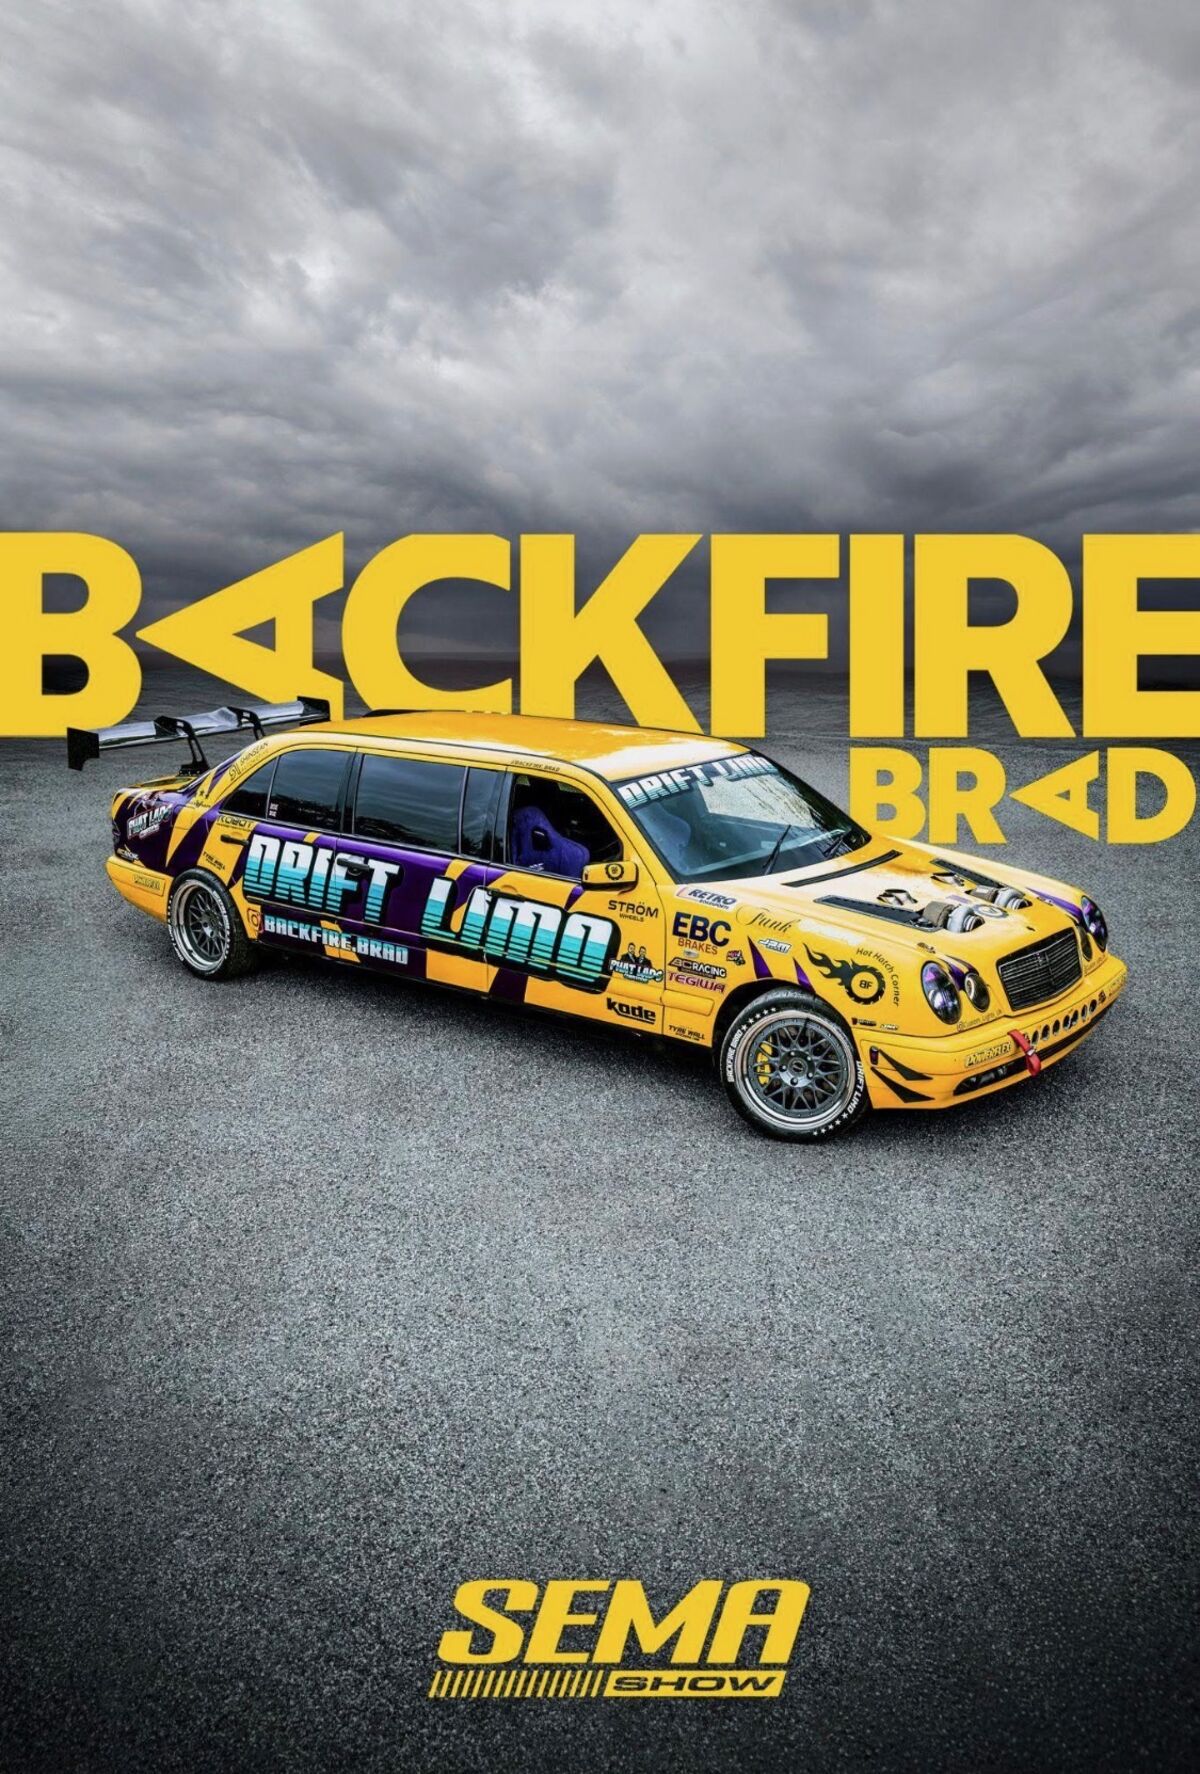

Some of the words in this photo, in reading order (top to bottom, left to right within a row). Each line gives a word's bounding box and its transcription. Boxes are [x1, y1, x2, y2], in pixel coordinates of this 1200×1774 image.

[617, 765, 712, 809] DRIFT
[715, 756, 779, 781] LIMO
[243, 834, 401, 923] DRIFT
[421, 877, 613, 983] LIMO
[687, 888, 737, 905] RETRO
[608, 900, 659, 919] STRÖM
[619, 913, 644, 923] WHEELS
[264, 914, 409, 965] BACKFIRE.BRAD
[672, 911, 732, 947] EBC
[677, 938, 718, 955] BRAKES
[610, 959, 636, 975] PHAT
[856, 947, 873, 957] Hot
[873, 951, 894, 973] Hatch
[890, 974, 901, 1007] Corner
[669, 972, 726, 993] TEGIWA
[855, 1060, 865, 1092] DRIFT
[847, 1090, 861, 1114] LIMO
